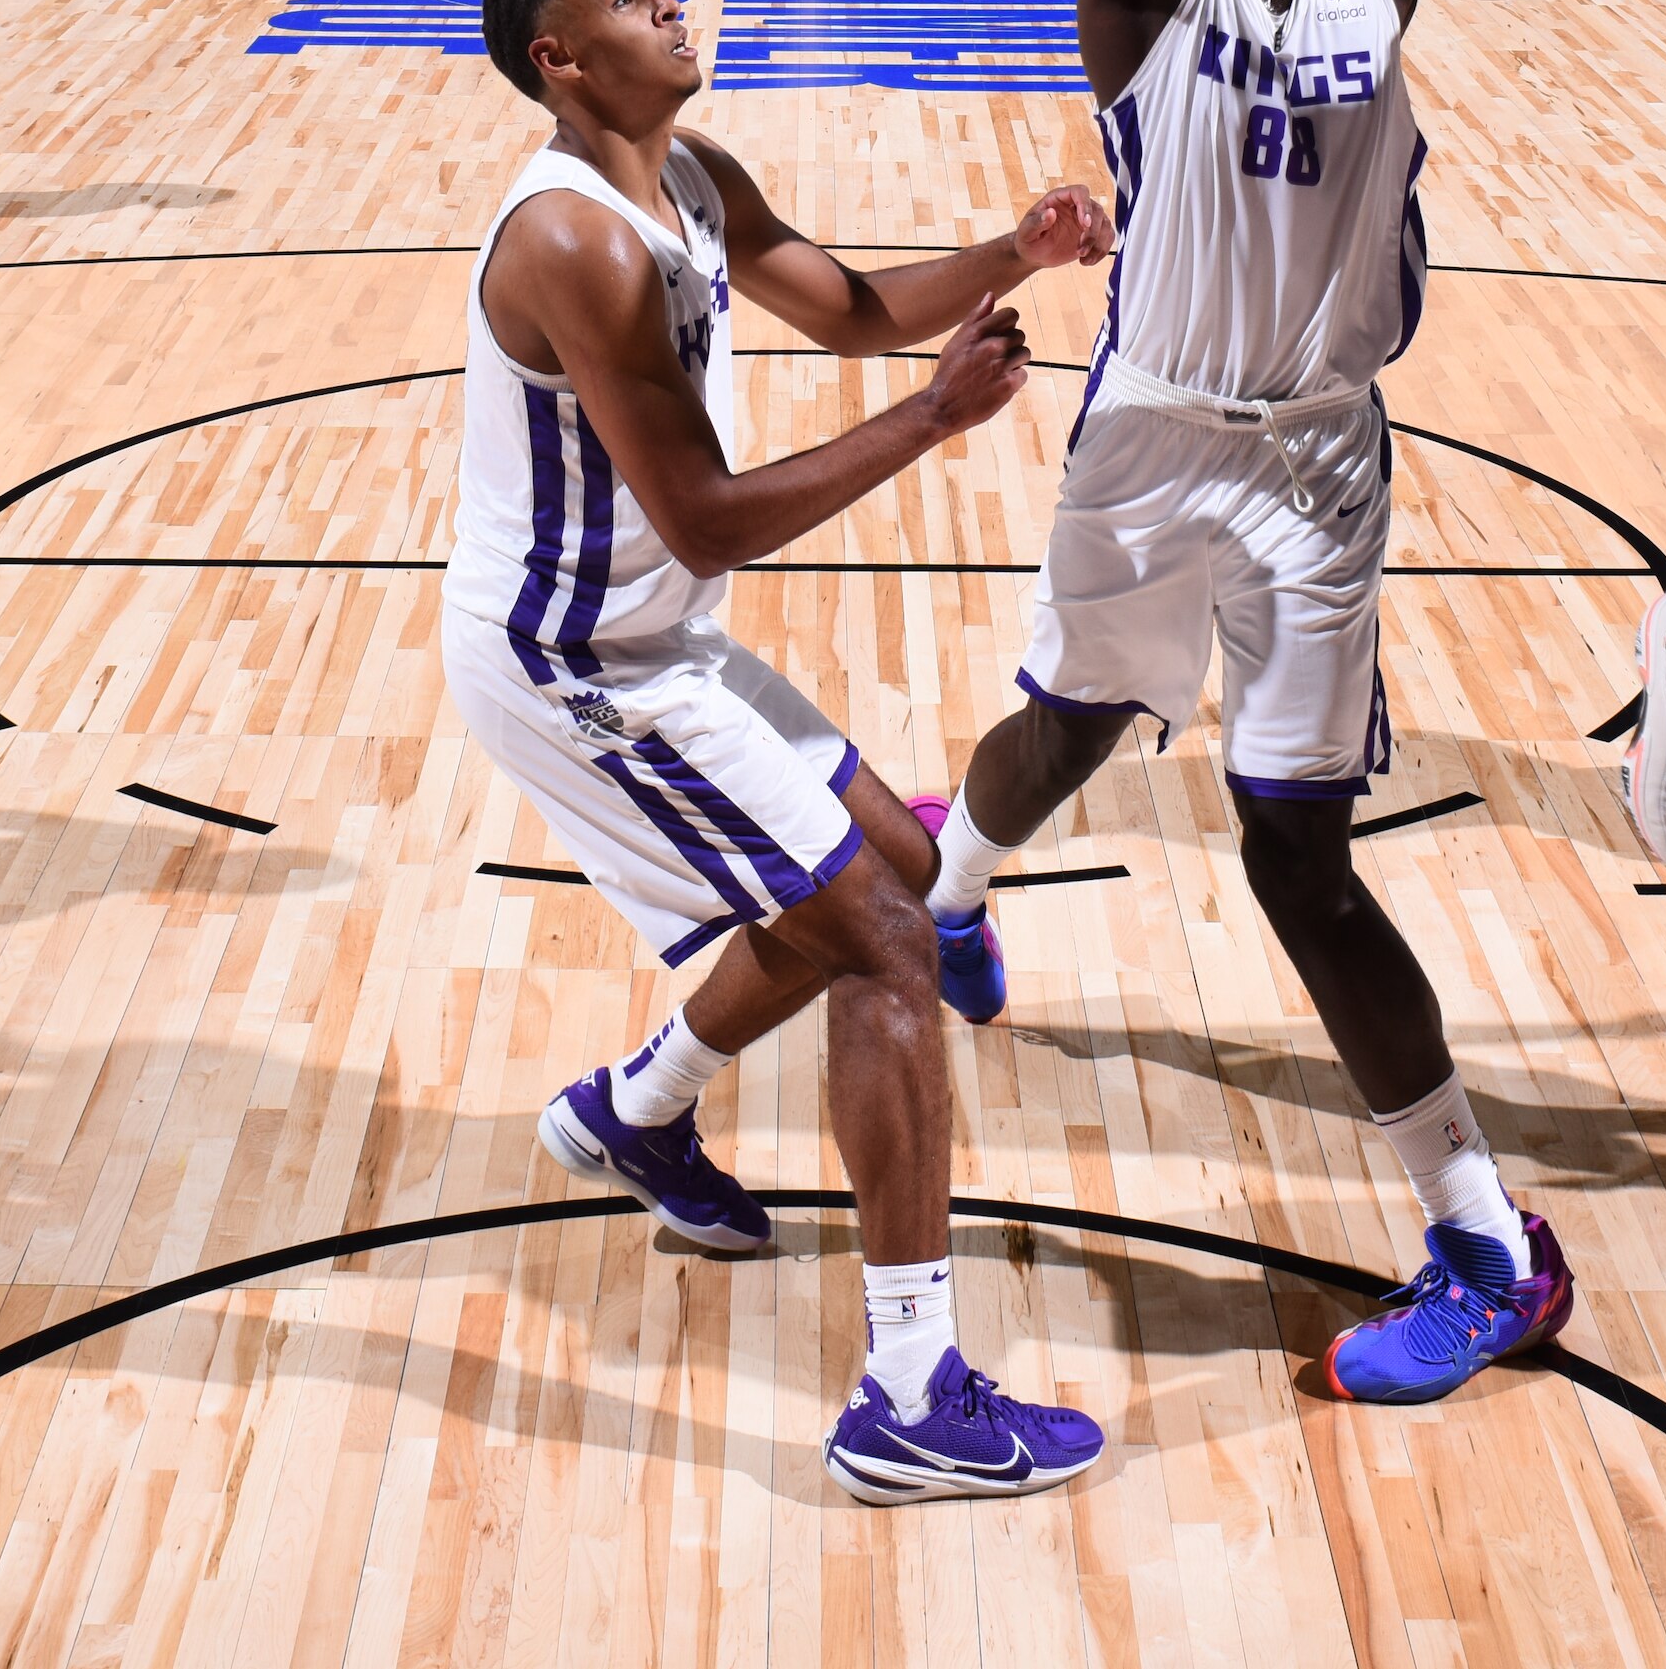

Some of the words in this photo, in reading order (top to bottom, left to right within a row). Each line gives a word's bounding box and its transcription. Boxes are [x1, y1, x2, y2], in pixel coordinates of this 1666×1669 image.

[1316, 2, 1367, 24] dialpad
[1197, 23, 1375, 109] KINGS
[1241, 104, 1321, 187] 88
